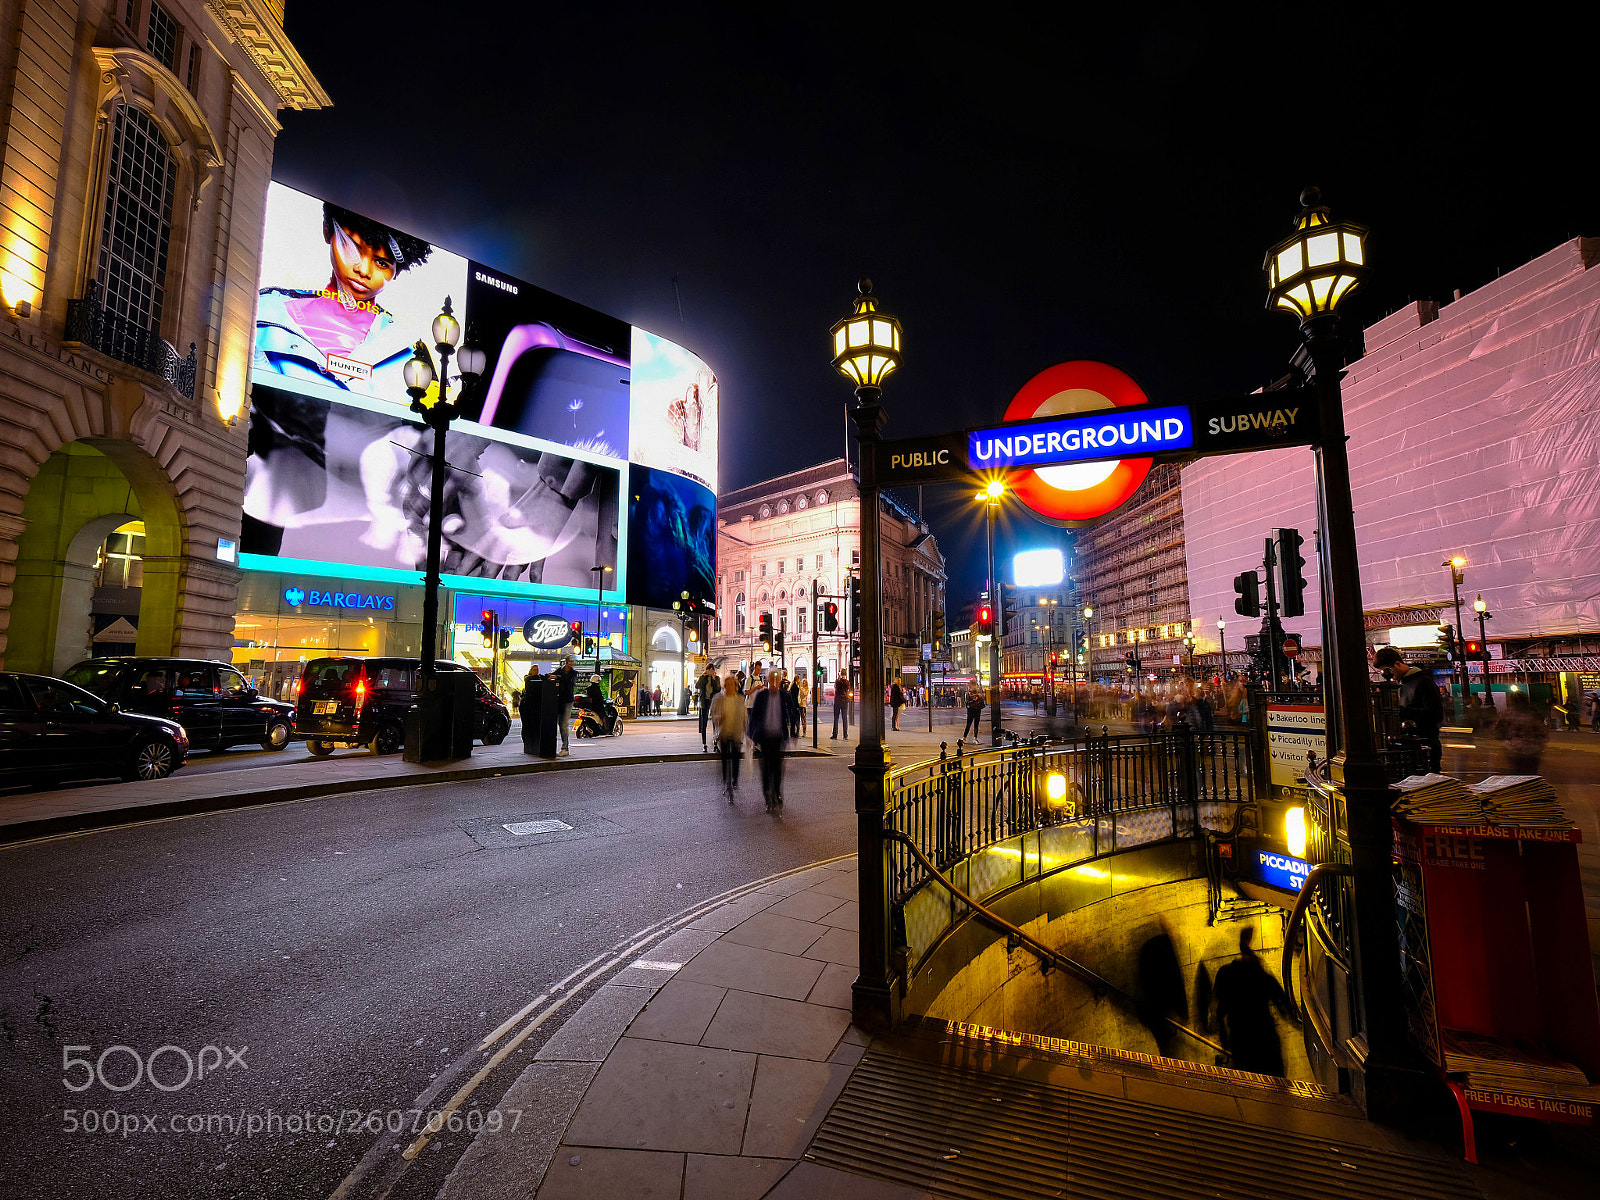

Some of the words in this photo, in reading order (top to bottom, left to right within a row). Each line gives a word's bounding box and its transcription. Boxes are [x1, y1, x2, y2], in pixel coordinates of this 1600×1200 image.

[475, 271, 518, 295] SAMSUNG
[11, 327, 116, 385] ALLIANCE
[165, 402, 190, 422] IFE
[330, 360, 369, 376] HUNTER
[1208, 407, 1299, 436] SUBWAY
[975, 417, 1184, 461] UNDERGROUND
[891, 449, 949, 469] PUBLIC
[308, 590, 394, 610] BARCLAYS
[528, 619, 569, 643] Boots
[1468, 665, 1480, 673] ANK
[1480, 664, 1506, 673] RBBERY
[1276, 713, 1308, 723] Bakerloo
[1310, 715, 1326, 725] line
[1277, 734, 1313, 747] Piccadilly
[1314, 737, 1326, 746] lin
[1278, 751, 1304, 761] Visitor
[1434, 825, 1462, 835] FREE
[1466, 825, 1510, 839] PLEASE
[1513, 827, 1542, 840] TAKE
[1423, 836, 1485, 861] FREE
[1471, 861, 1486, 870] ONE
[1289, 875, 1304, 889] ST
[1463, 1089, 1491, 1103] FREE
[1493, 1093, 1536, 1109] PLEASE
[1538, 1099, 1567, 1114] TAKE
[1569, 1104, 1593, 1118] ONE
